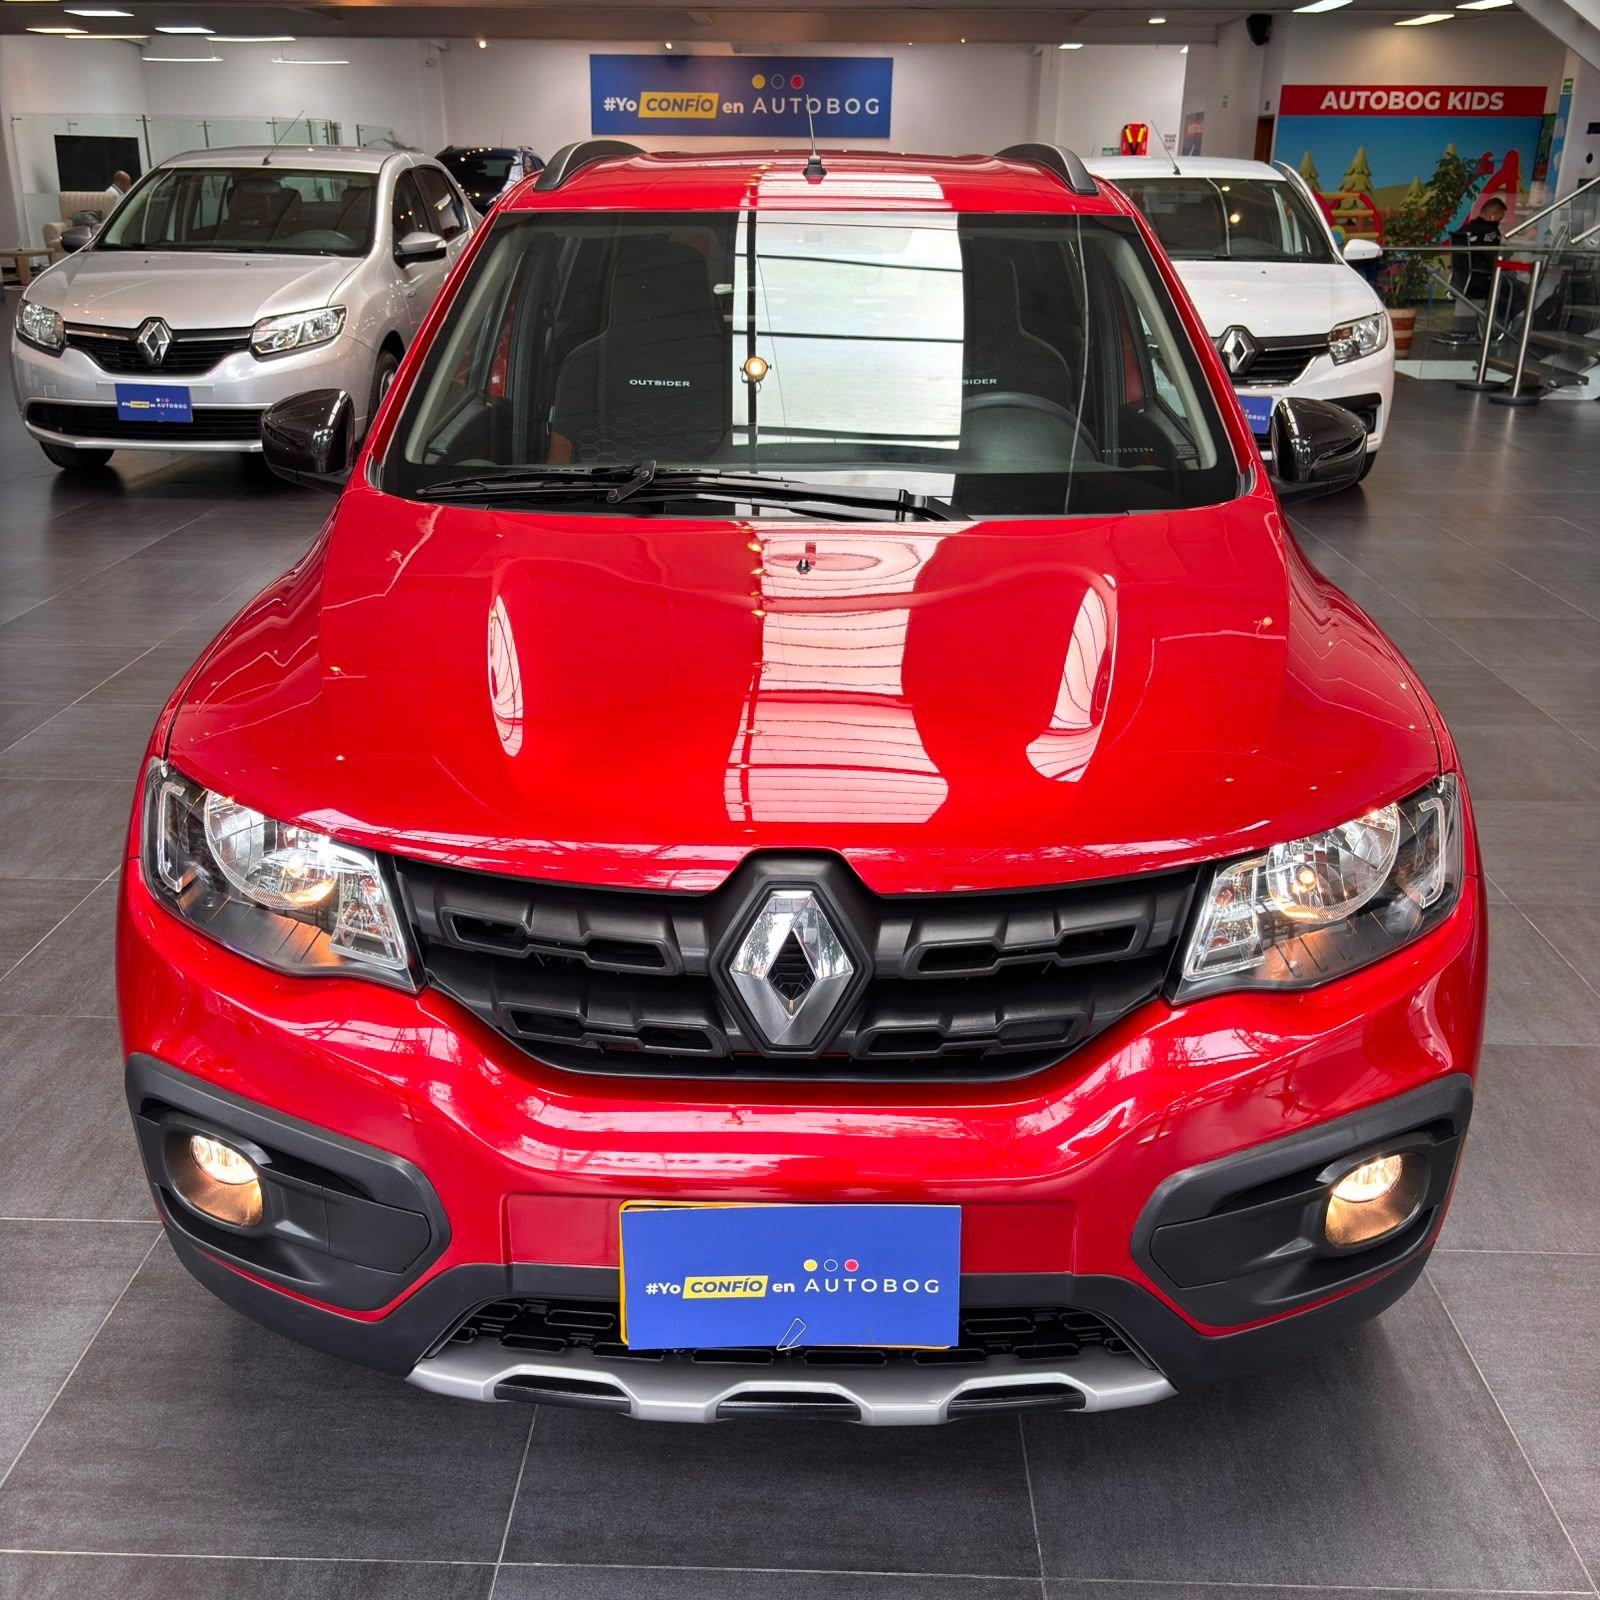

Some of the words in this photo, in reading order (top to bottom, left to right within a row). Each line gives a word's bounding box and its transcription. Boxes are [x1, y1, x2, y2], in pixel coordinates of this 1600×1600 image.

[603, 96, 637, 112] #Yo
[646, 94, 714, 113] CONFÍO
[722, 100, 744, 114] en
[752, 96, 880, 115] AUTOBOG
[1320, 90, 1442, 111] AUTOBOG
[1447, 91, 1505, 111] KIDS
[629, 379, 690, 387] OUTSIDER
[645, 1281, 682, 1295] #Yo
[691, 1277, 764, 1295] CONFÍO
[772, 1282, 796, 1294] en
[804, 1278, 940, 1294] AUTOBOG
